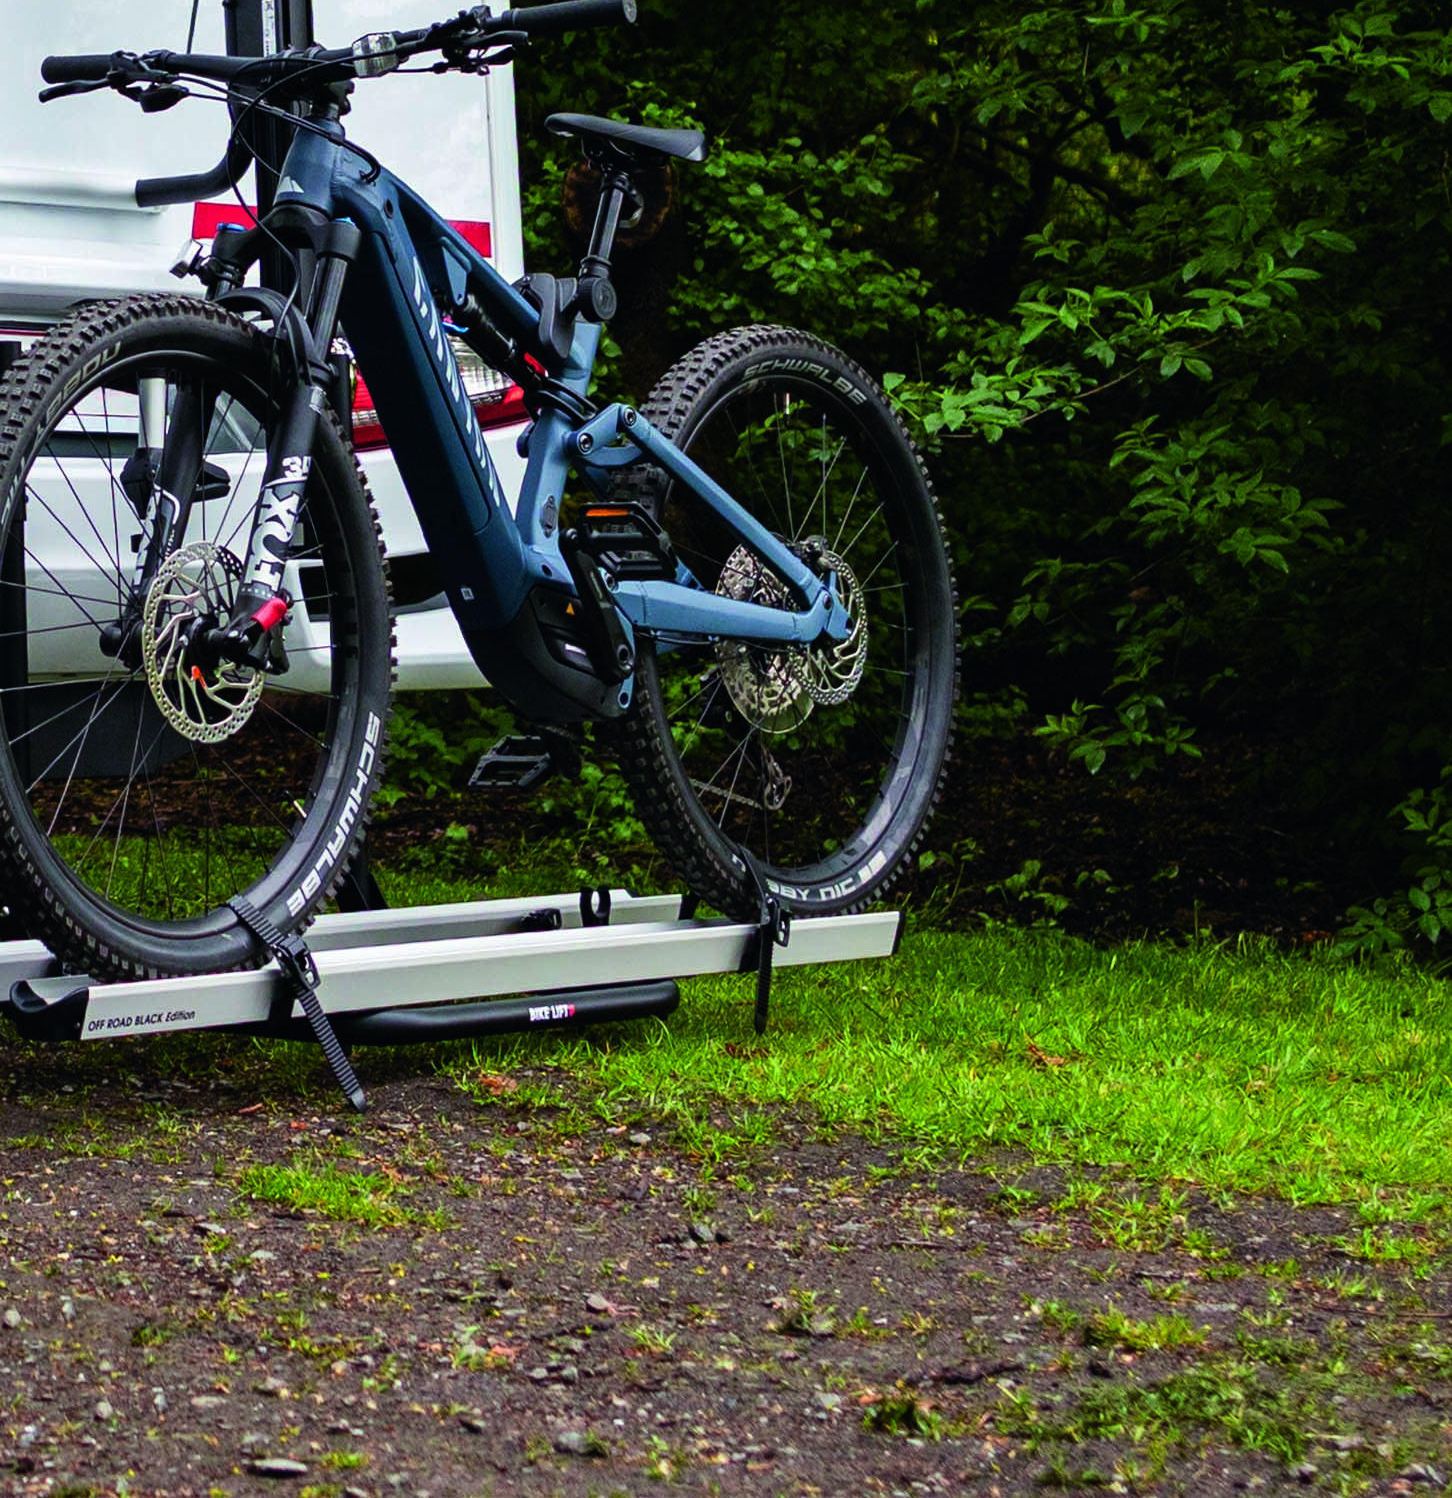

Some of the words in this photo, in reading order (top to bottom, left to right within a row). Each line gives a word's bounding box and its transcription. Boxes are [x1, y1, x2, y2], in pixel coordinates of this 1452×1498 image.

[744, 359, 867, 405] SCHWALBE
[244, 488, 303, 592] FOX
[286, 711, 381, 917] SCHWALBE
[88, 1020, 105, 1031] OFF
[107, 1017, 133, 1029] ROAD
[135, 1014, 163, 1026] BLACK
[165, 1011, 196, 1022] Edition
[529, 1006, 550, 1022] BIKE
[551, 1004, 569, 1019] LIFT
